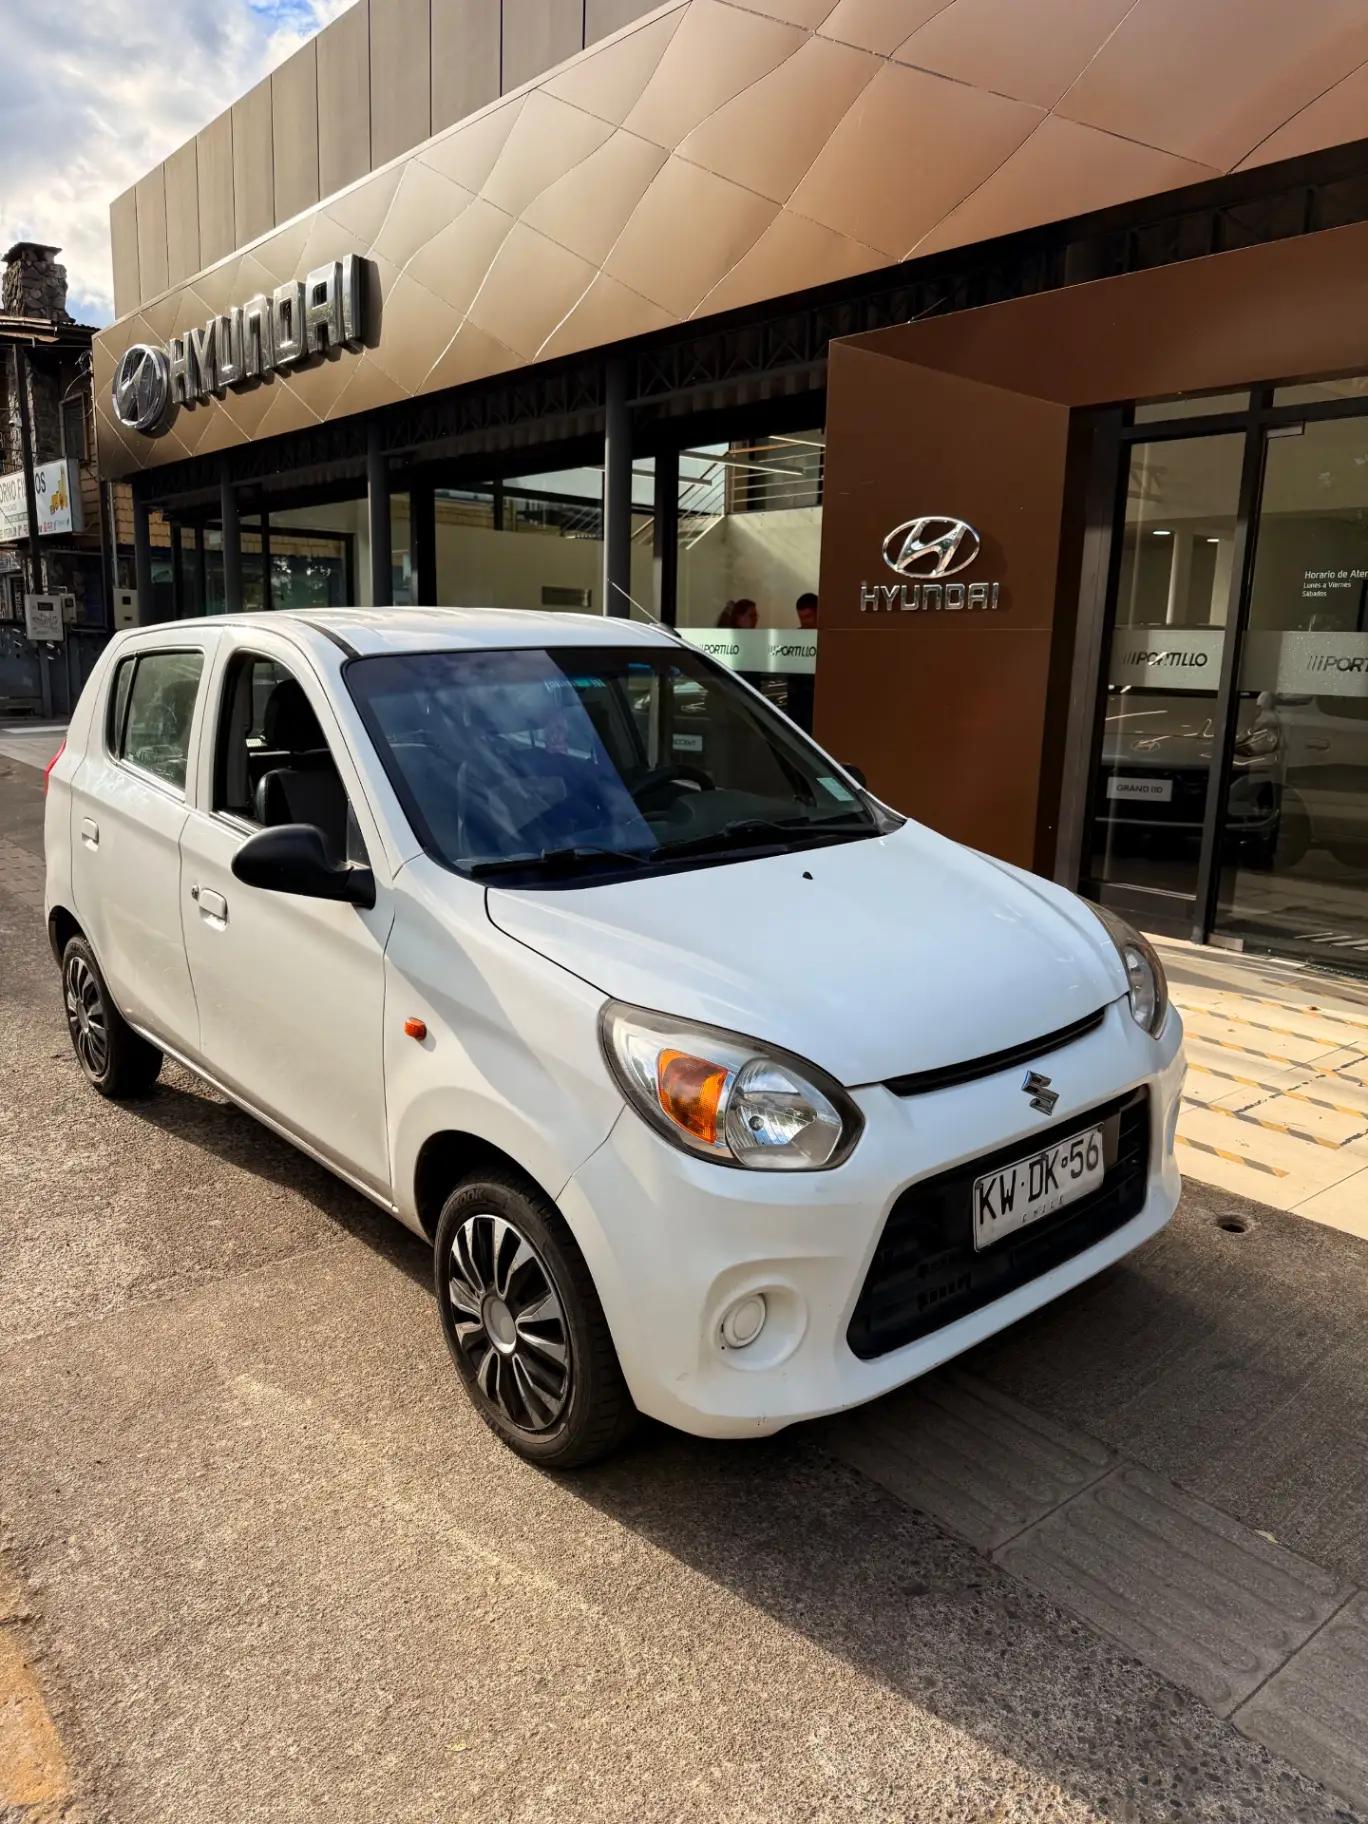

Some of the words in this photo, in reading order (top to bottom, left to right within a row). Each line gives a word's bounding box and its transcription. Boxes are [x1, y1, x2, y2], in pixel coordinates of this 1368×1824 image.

[168, 252, 362, 405] HYUNDAI
[1304, 570, 1335, 579] Horario
[1337, 570, 1348, 579] de
[860, 581, 1000, 612] HYUNDAI
[1116, 784, 1149, 793] GRAND
